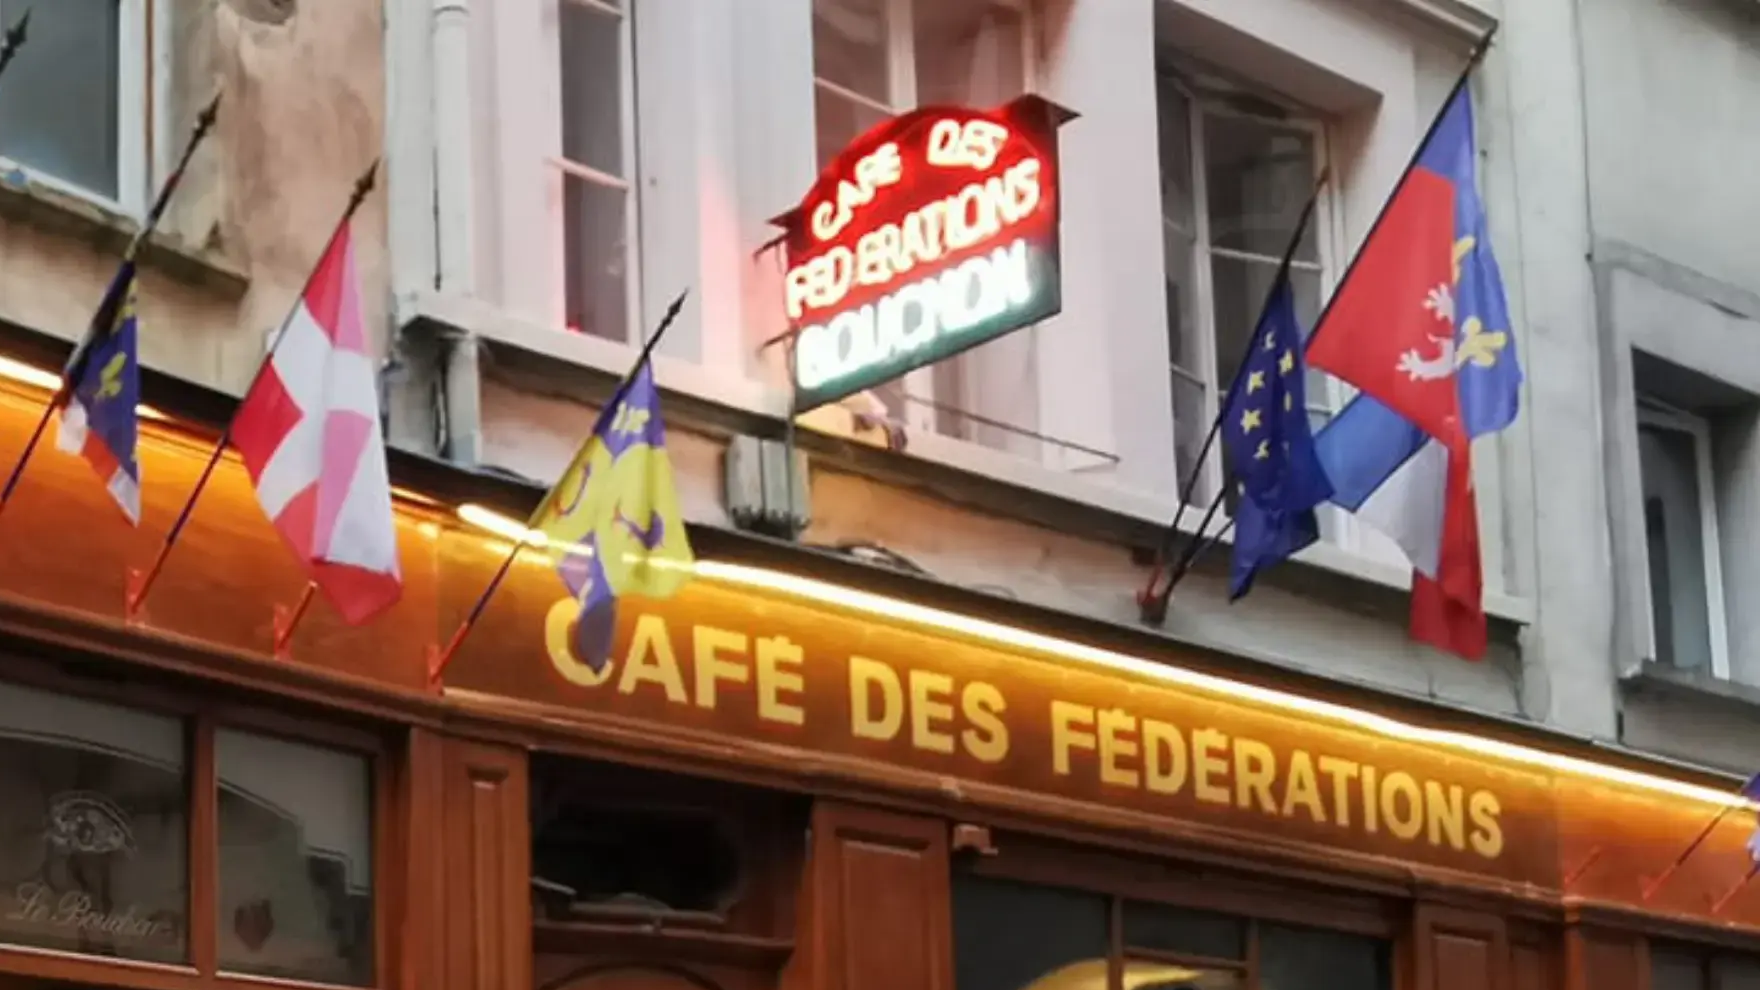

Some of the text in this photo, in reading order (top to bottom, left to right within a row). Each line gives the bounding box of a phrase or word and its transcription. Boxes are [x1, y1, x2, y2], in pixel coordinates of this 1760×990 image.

[544, 596, 1505, 858] CAFÉ DES FÉDÉRATIONS
